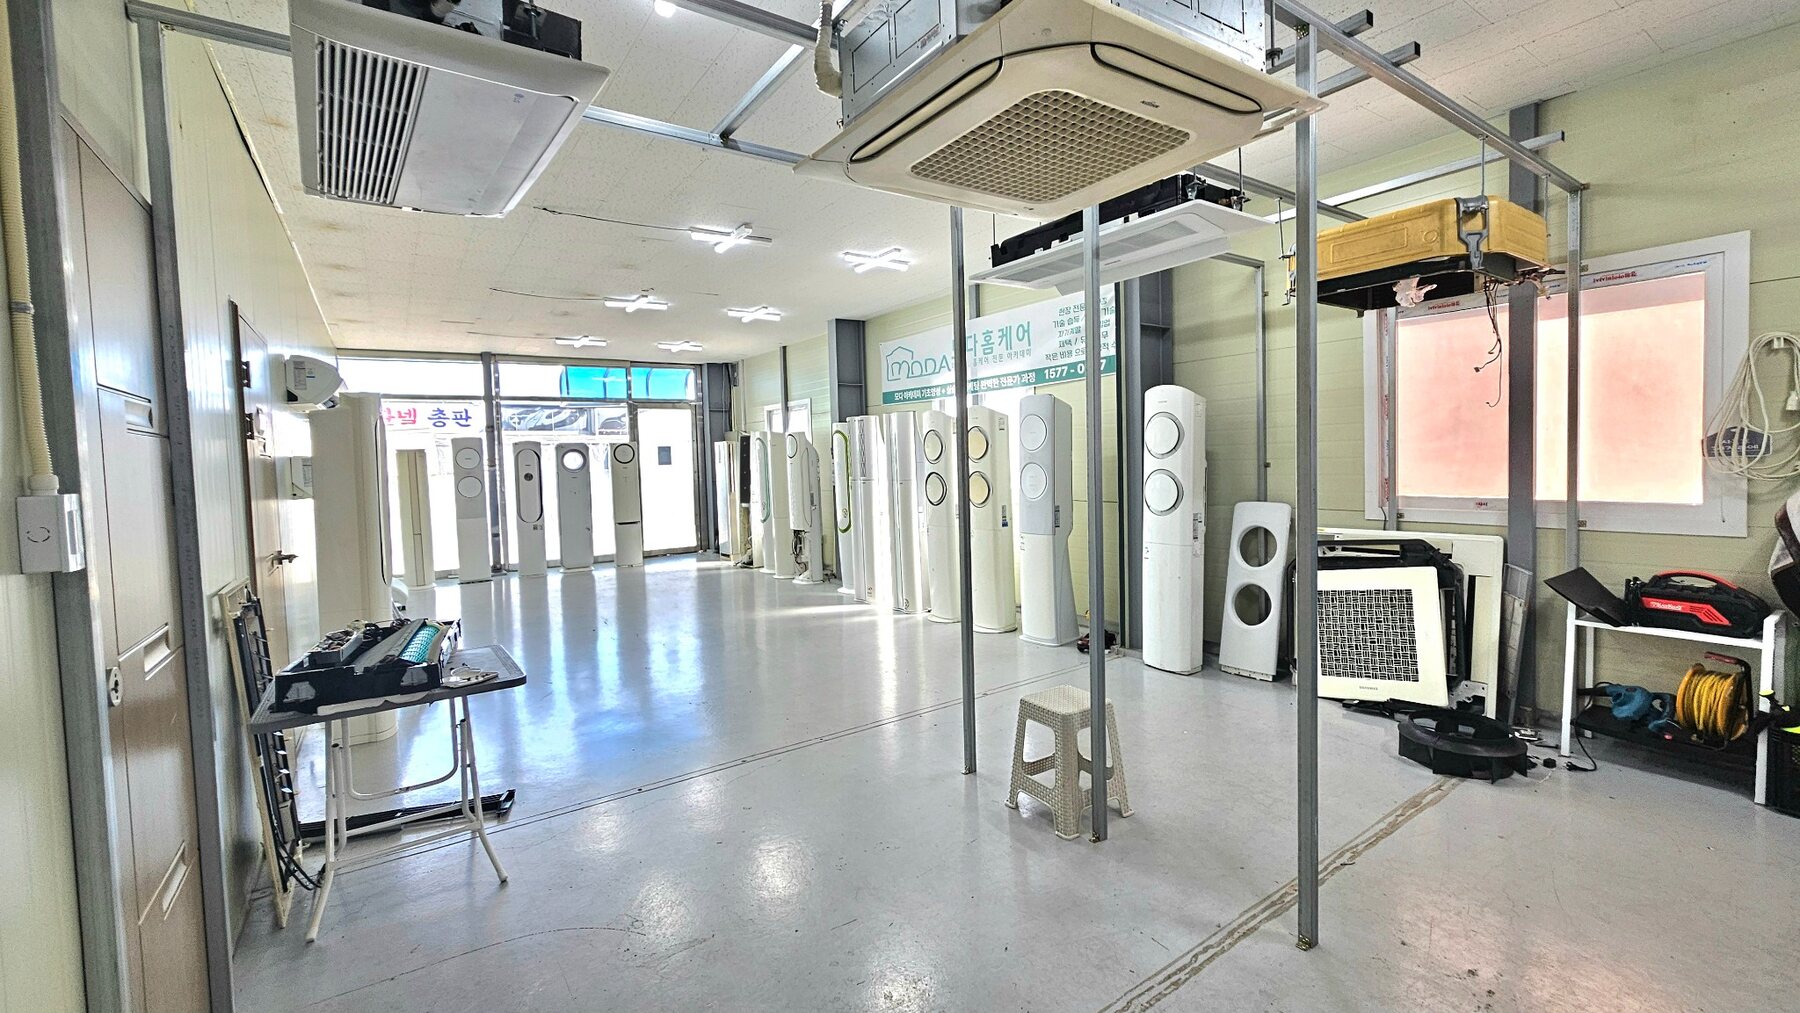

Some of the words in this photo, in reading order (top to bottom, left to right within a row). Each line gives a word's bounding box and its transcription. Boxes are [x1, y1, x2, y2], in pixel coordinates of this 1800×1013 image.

[965, 320, 1032, 358] 다홈케어
[1006, 347, 1032, 361] 아카데미
[1060, 349, 1073, 359] 비용
[1020, 370, 1036, 383] 과정
[1044, 366, 1068, 379] 1577
[1077, 359, 1106, 374] 07
[427, 407, 472, 428] 총판
